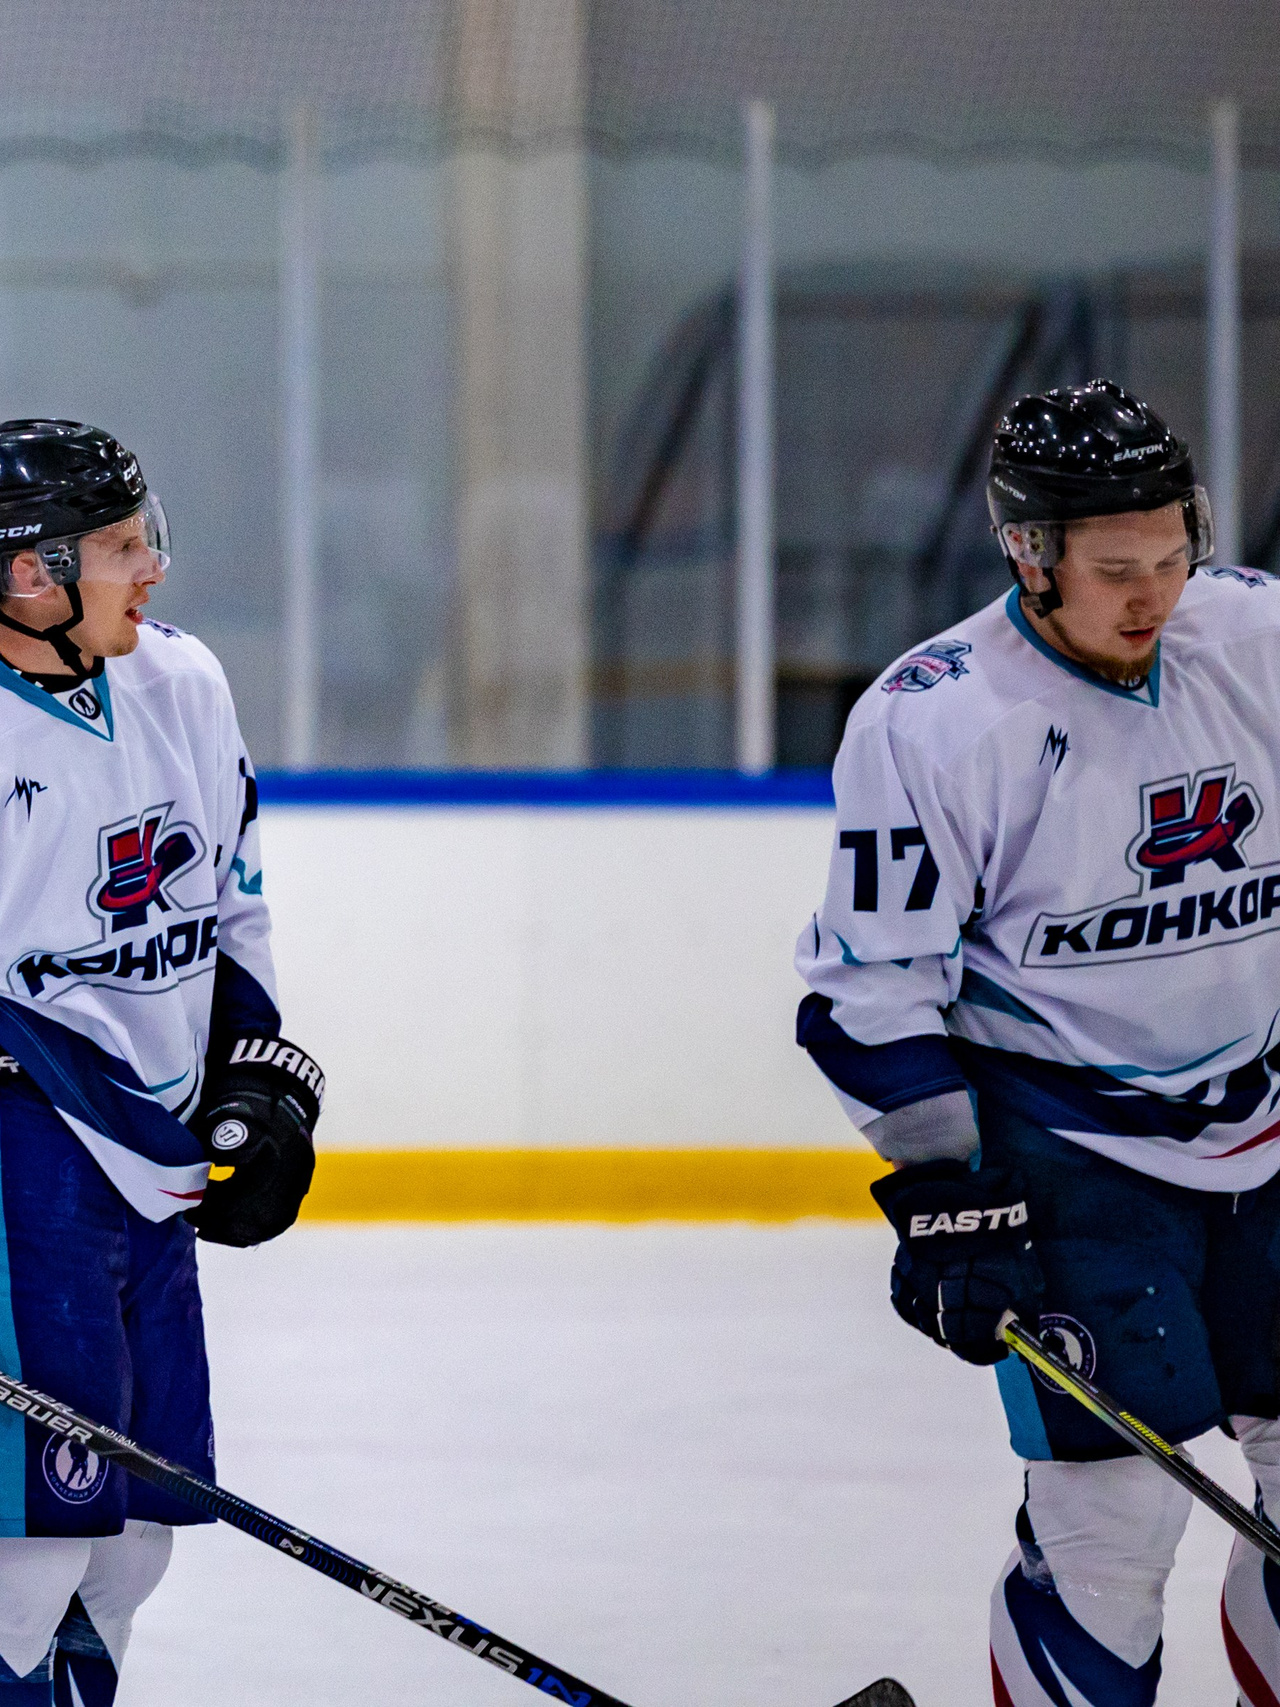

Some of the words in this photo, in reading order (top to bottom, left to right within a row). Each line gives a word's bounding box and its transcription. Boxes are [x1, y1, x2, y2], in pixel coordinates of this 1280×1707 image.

[1113, 443, 1164, 462] EASTON
[839, 825, 940, 912] 17
[909, 1200, 1029, 1238] EASTO
[360, 1578, 524, 1675] NEXUS
